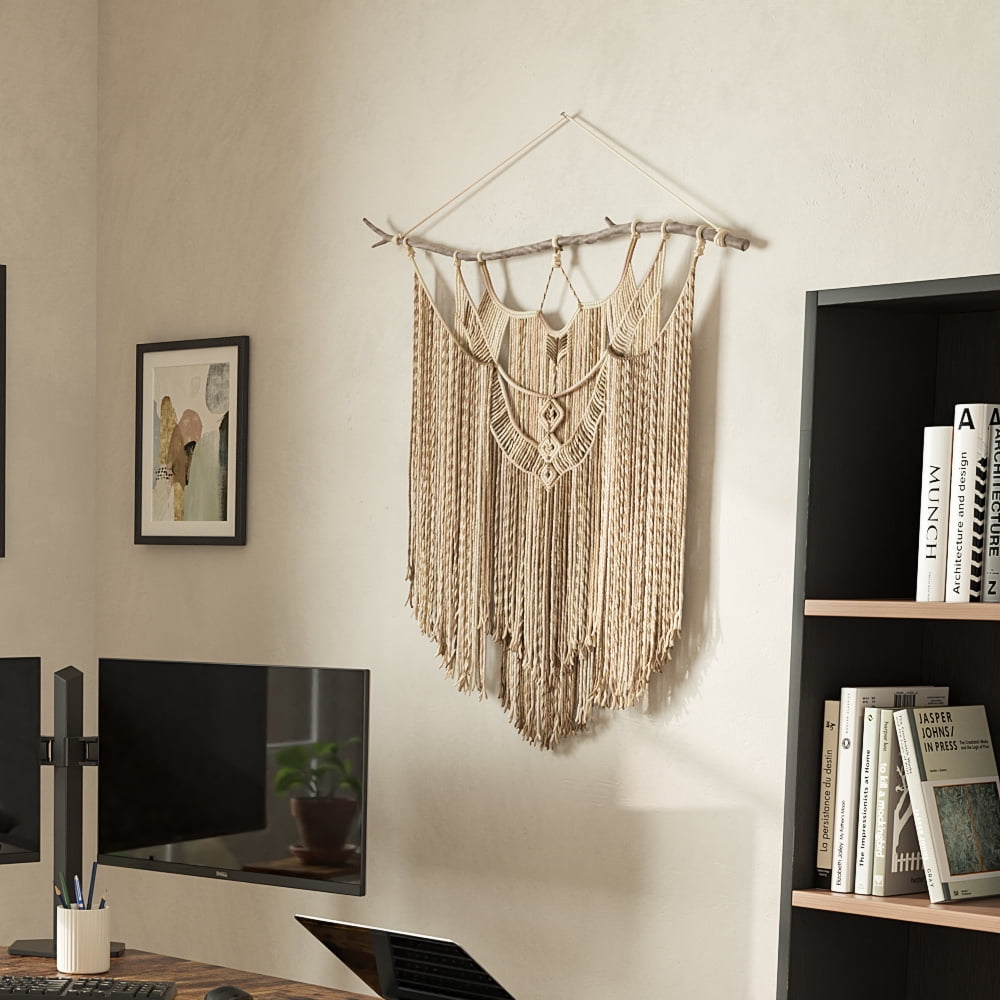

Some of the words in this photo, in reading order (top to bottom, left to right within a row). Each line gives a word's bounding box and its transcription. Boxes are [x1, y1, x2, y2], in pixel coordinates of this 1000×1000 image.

[958, 408, 975, 430] A
[958, 452, 968, 491] design
[926, 465, 941, 559] MUNCH
[957, 495, 965, 518] and
[953, 521, 964, 594] Architecture
[919, 711, 953, 724] JASPER
[922, 726, 954, 738] JOHNS/
[924, 742, 933, 752] IN
[935, 741, 957, 751] PRESS
[824, 749, 833, 773] destin
[880, 763, 887, 773] to
[822, 777, 831, 788] du
[880, 776, 888, 789] kill
[821, 790, 831, 840] persistance
[860, 787, 868, 849] Impressionists
[864, 776, 870, 784] at
[875, 799, 886, 858] mockingbird
[820, 842, 828, 852] La
[927, 868, 935, 888] GRAY
